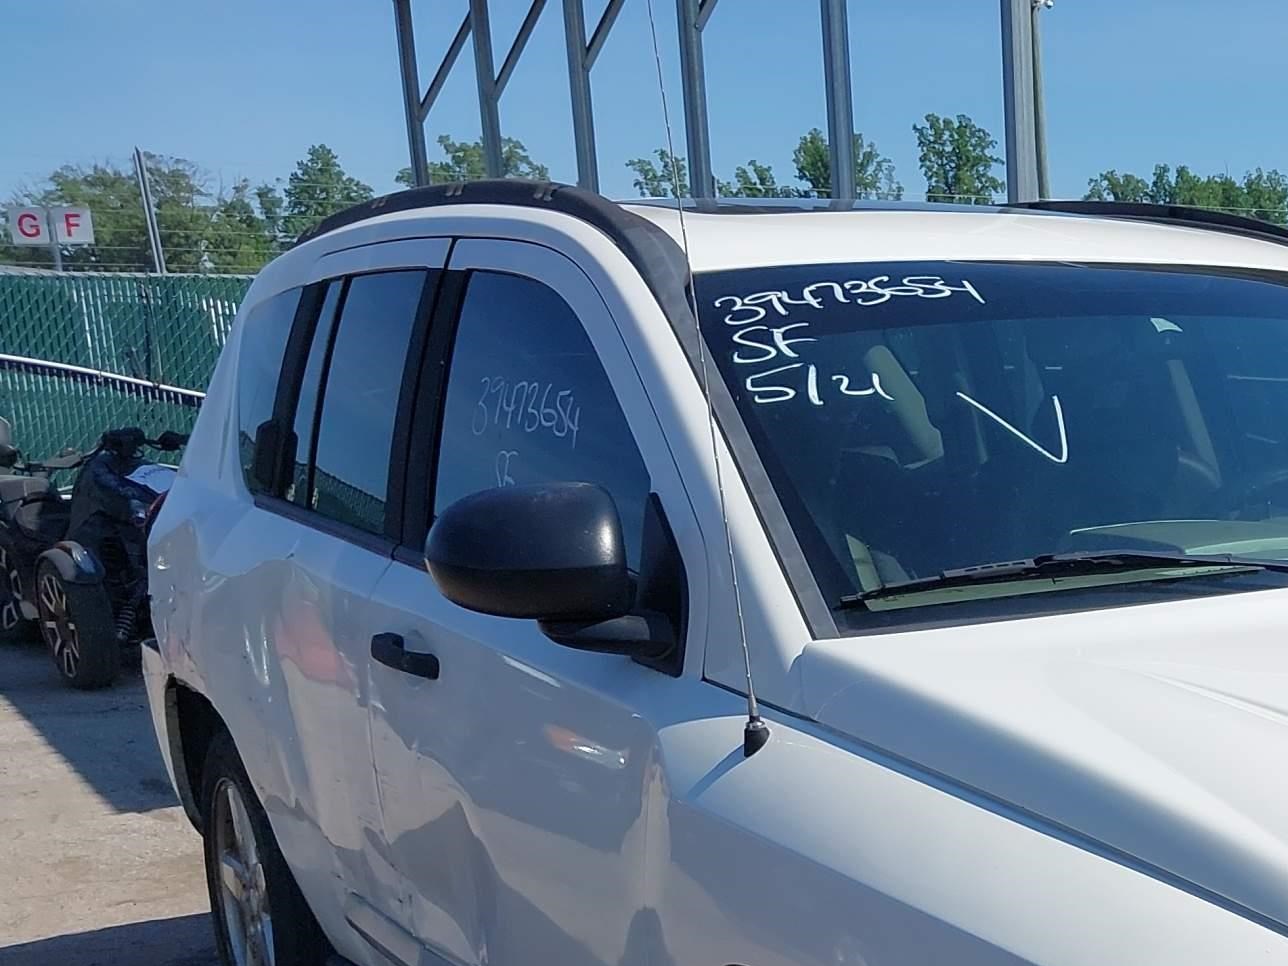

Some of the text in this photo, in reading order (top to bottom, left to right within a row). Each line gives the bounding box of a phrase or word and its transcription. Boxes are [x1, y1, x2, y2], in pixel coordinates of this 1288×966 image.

[18, 213, 80, 237] G F
[732, 322, 818, 363] SF
[472, 376, 581, 449] 39473654
